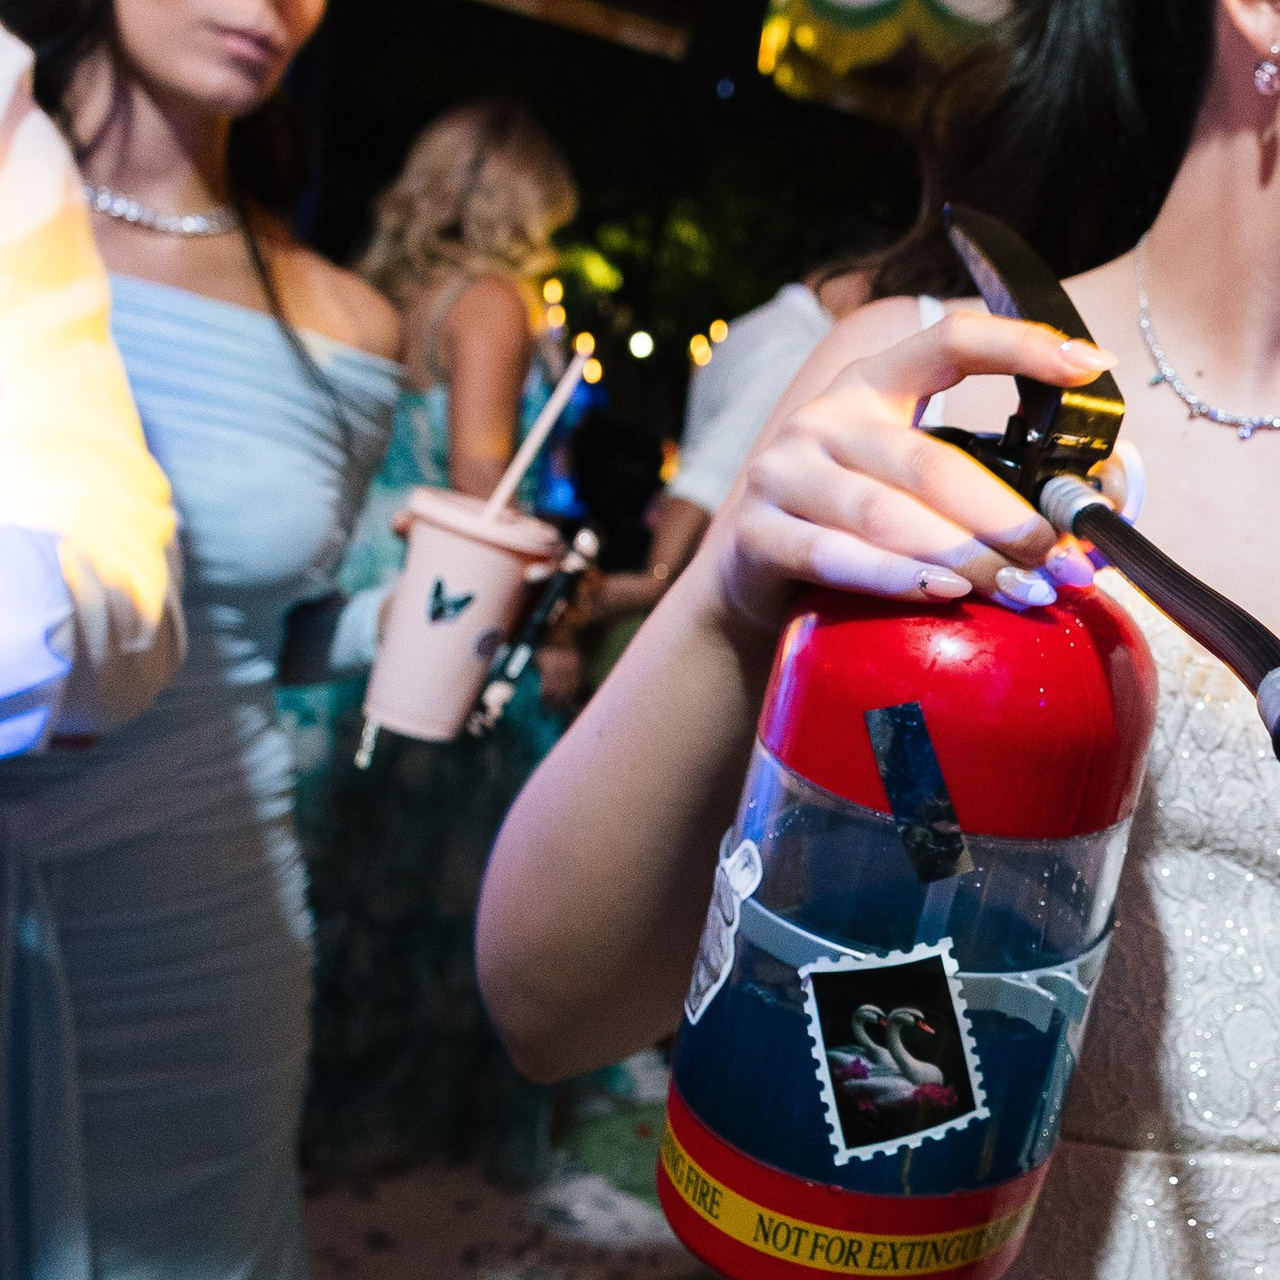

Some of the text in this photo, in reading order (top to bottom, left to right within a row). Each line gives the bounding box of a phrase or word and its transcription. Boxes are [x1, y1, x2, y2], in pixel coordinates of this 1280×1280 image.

[684, 1165, 723, 1220] FIRE
[753, 1213, 810, 1257] NOT
[808, 1231, 863, 1268] FOR
